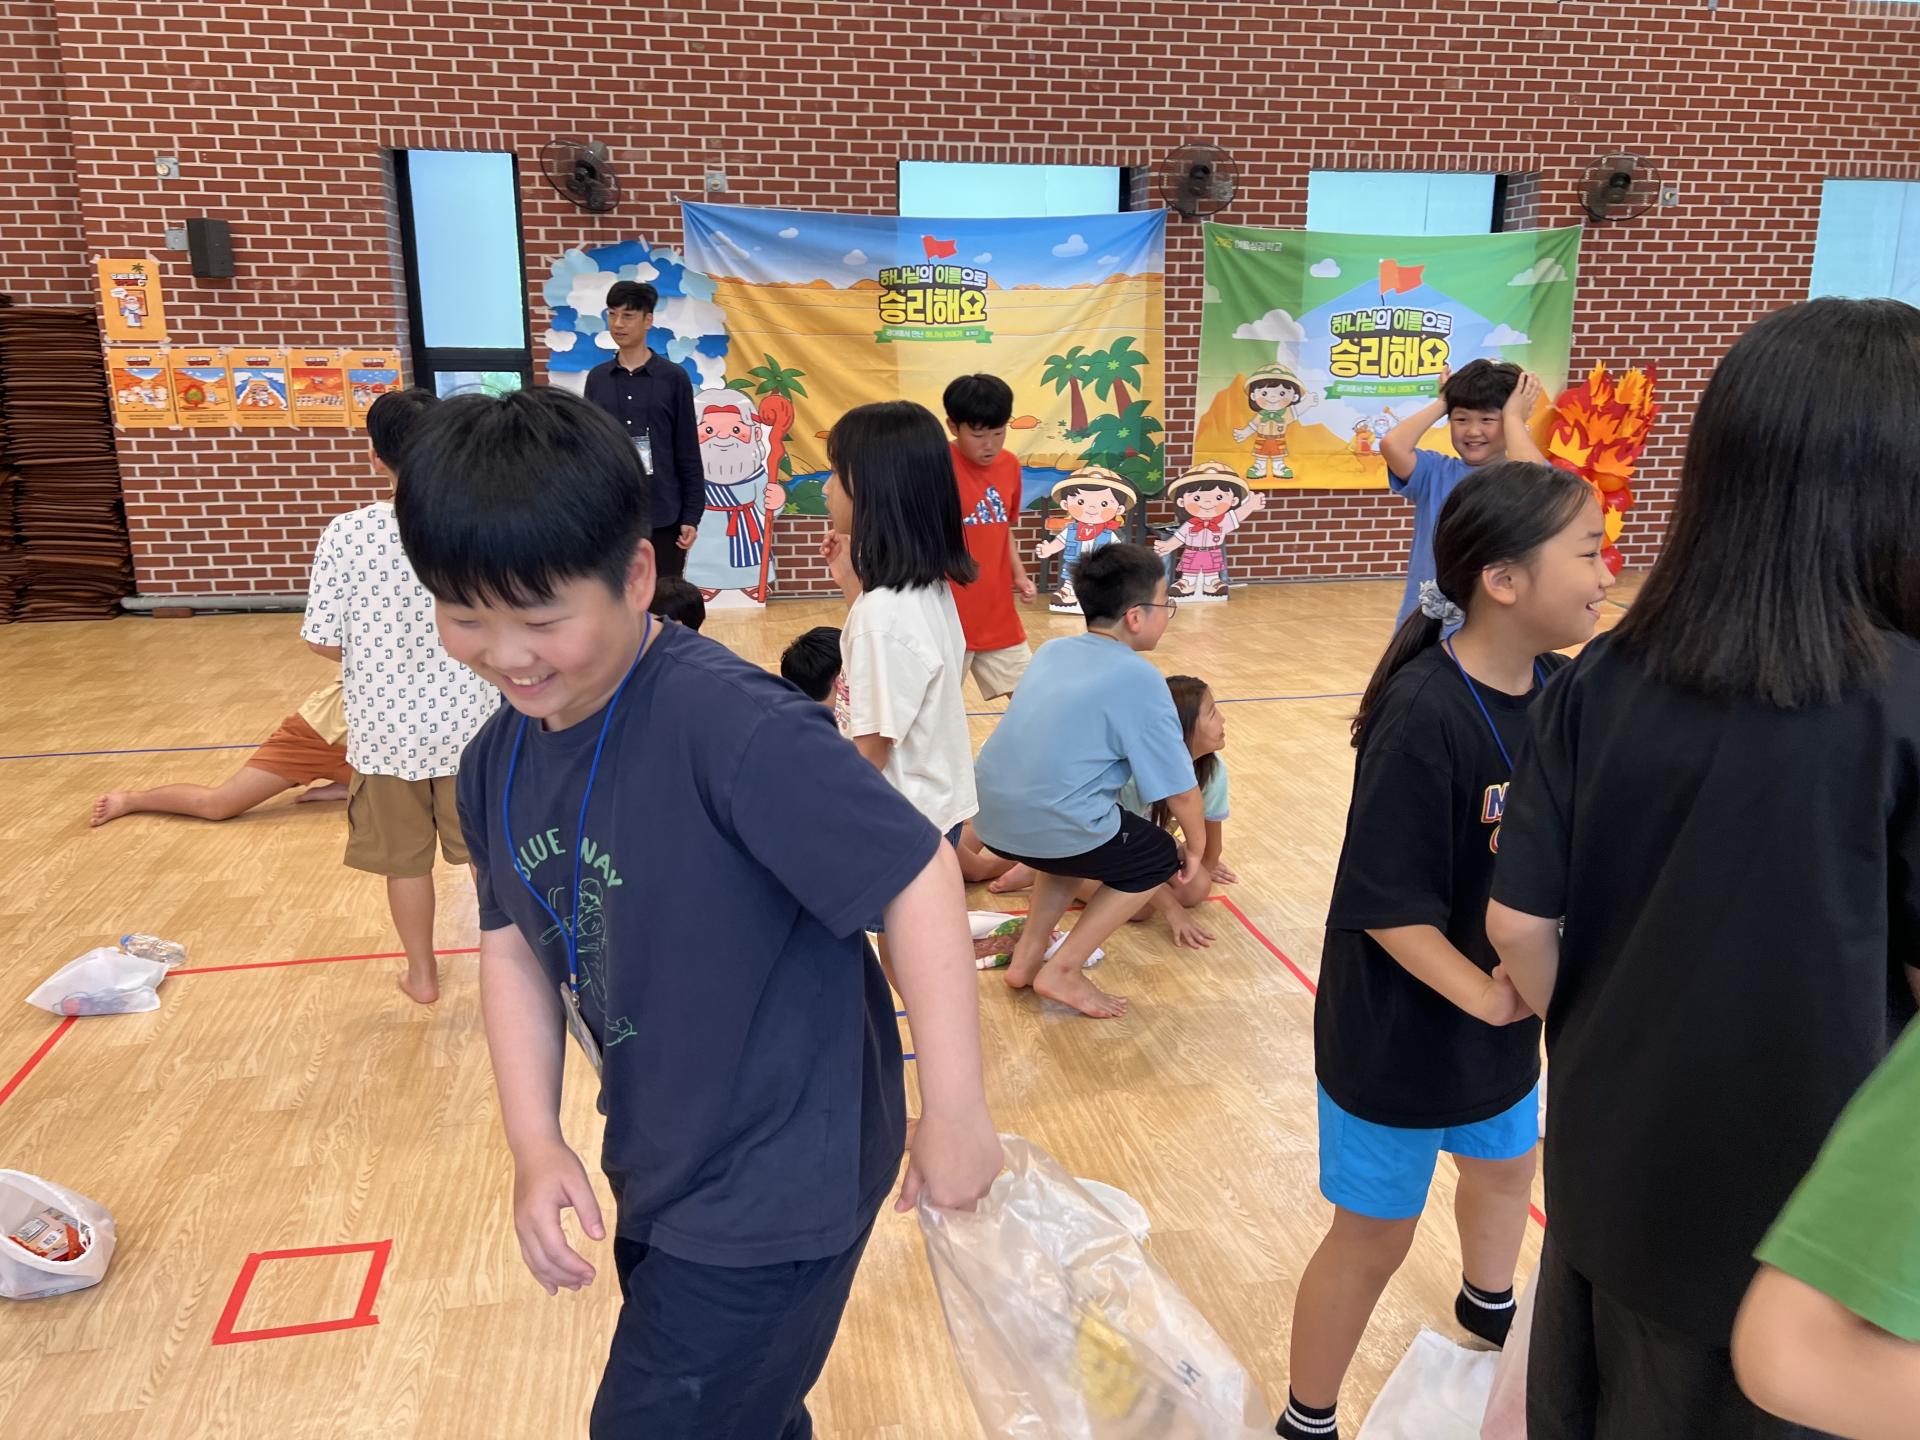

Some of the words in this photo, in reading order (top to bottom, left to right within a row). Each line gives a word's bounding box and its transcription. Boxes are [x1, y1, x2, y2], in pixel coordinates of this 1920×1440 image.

[880, 265, 932, 286] 하나님의
[935, 265, 988, 287] 이름으로
[880, 288, 987, 324] 승리해요
[1331, 309, 1391, 334] 하나님의
[1393, 309, 1451, 334] 이름으로
[1330, 336, 1449, 378] 승리해요
[513, 828, 566, 881] BLUE
